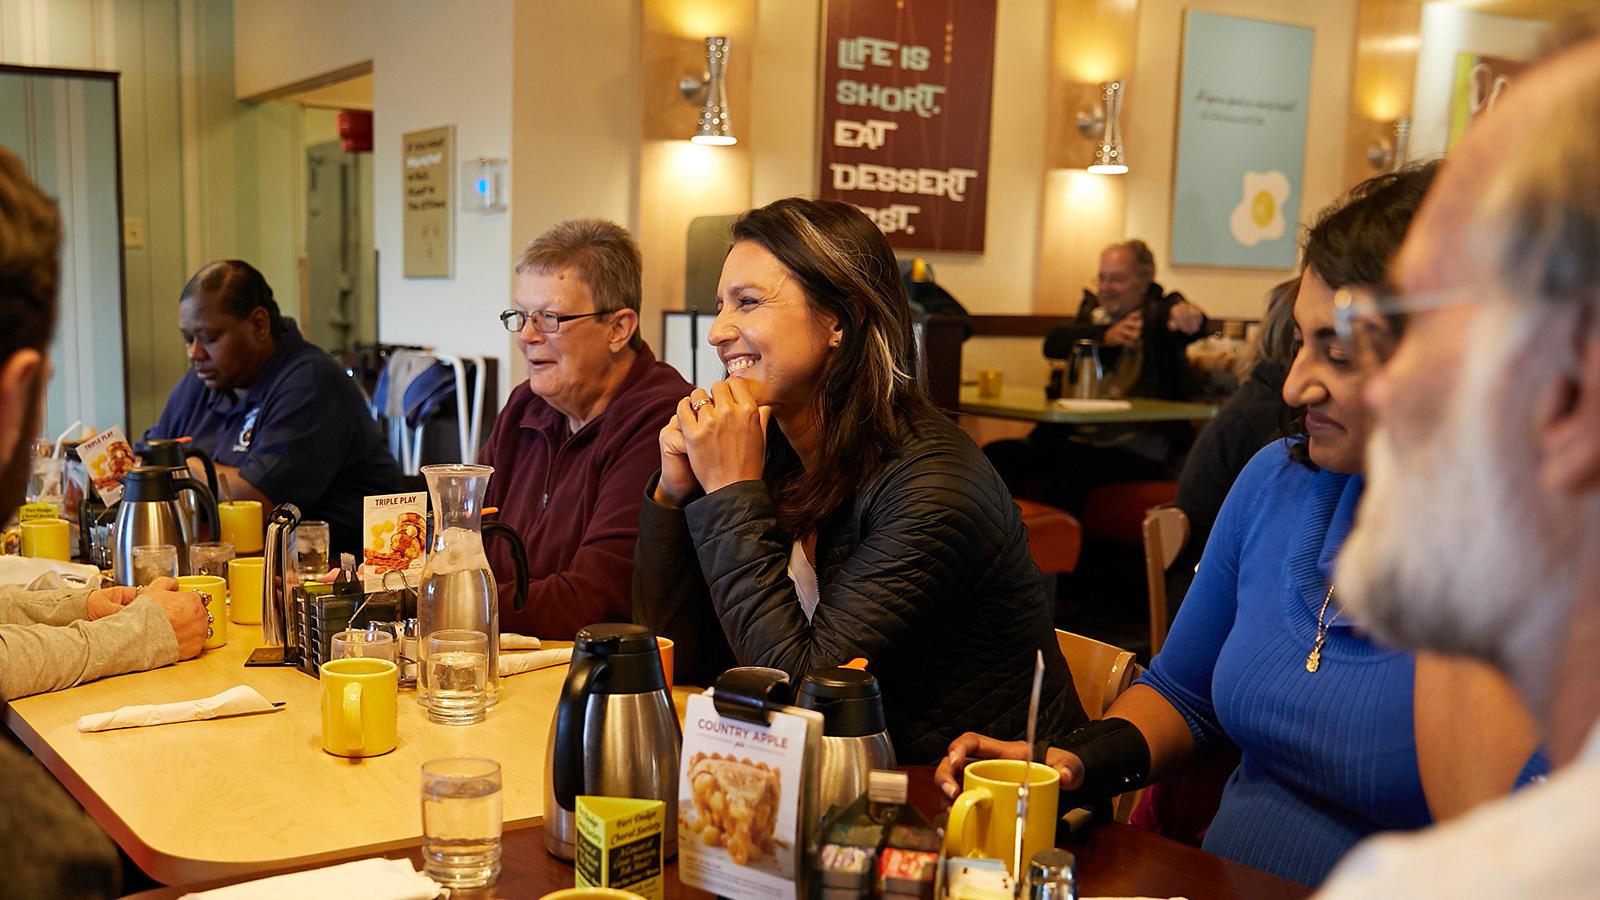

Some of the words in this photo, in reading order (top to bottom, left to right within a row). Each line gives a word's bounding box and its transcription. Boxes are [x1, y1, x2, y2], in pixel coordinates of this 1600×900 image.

[837, 36, 899, 70] LIFE
[901, 45, 931, 71] IS
[835, 80, 946, 118] SHORT.
[834, 119, 898, 150] EAT
[830, 163, 978, 202] DESSERT
[375, 498, 398, 506] TRIPLE
[400, 496, 417, 504] PLAY
[697, 718, 750, 739] COUNTRY
[752, 731, 789, 749] APPLE
